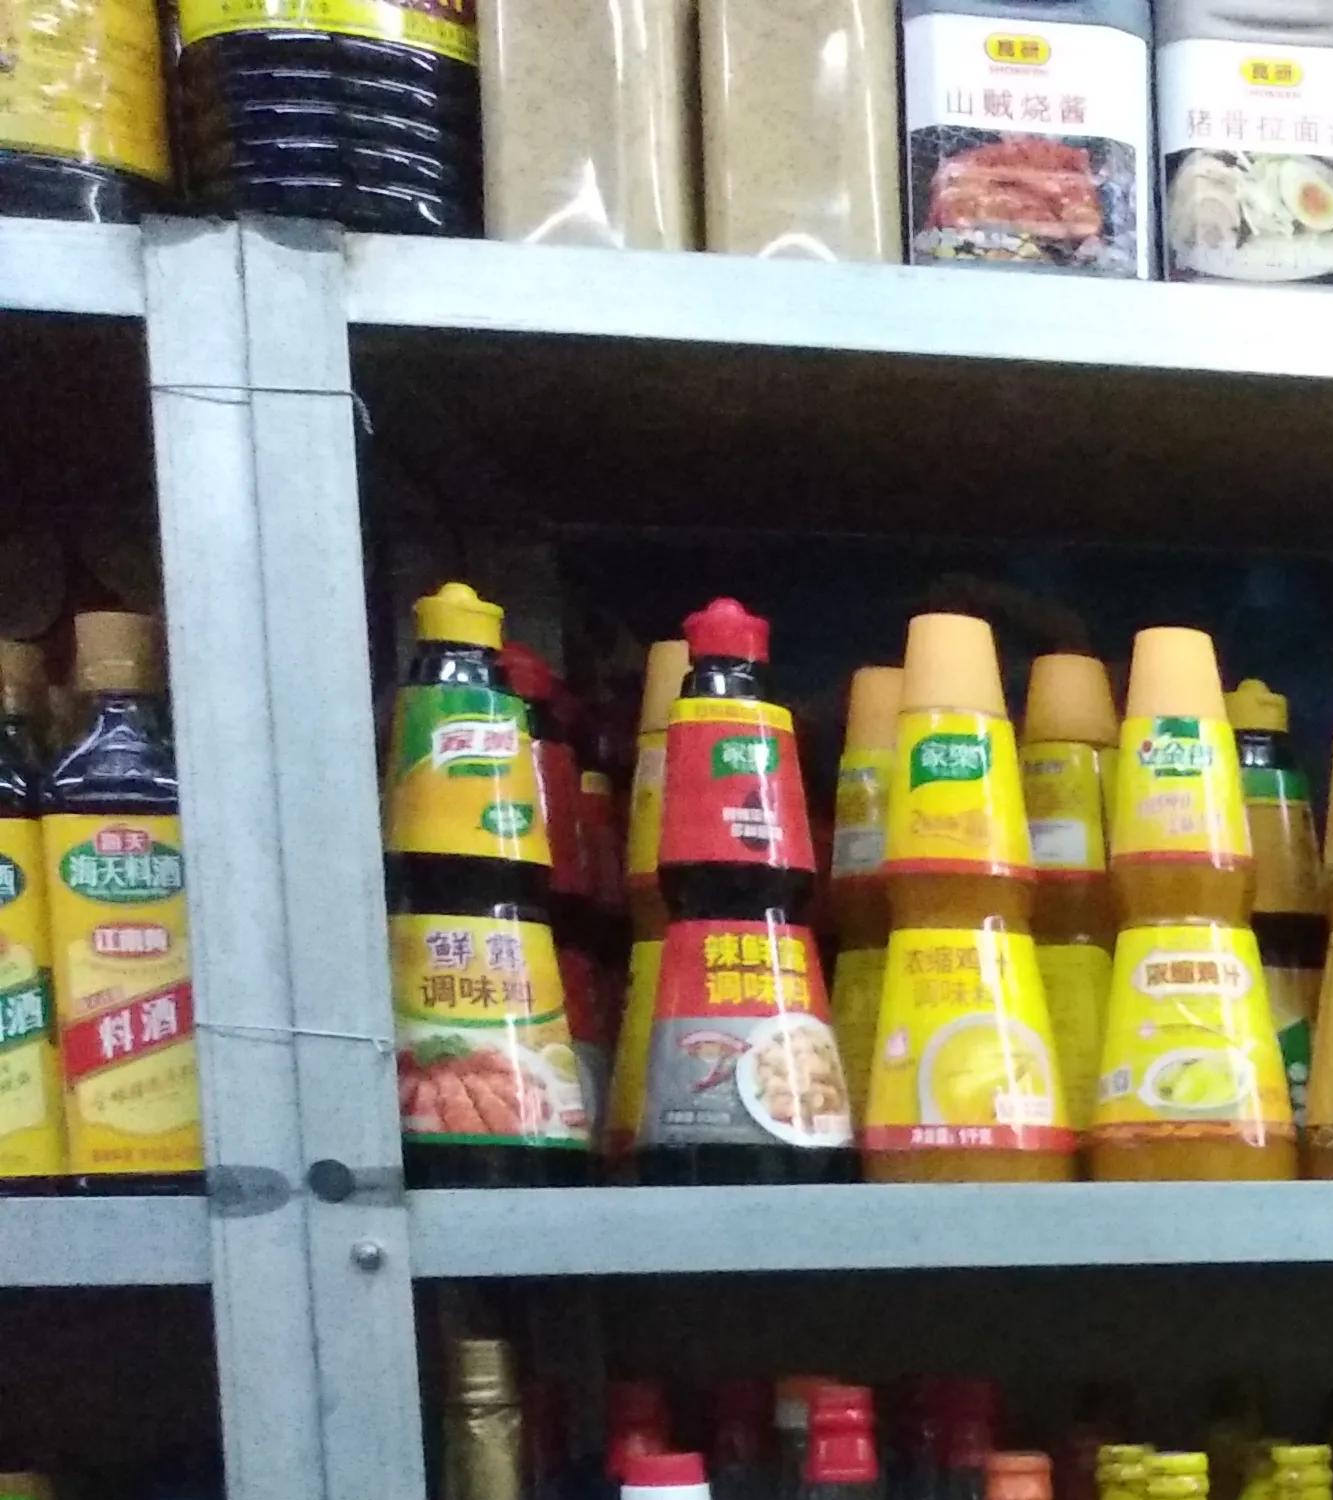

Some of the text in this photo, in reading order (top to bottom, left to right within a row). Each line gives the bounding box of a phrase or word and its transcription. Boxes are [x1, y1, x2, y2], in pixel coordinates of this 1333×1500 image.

[946, 87, 1087, 124] 山贼烧酱
[70, 853, 182, 889] 海天料酒
[426, 931, 522, 970] 鲜露
[419, 975, 533, 1013] 调味料
[705, 971, 811, 1010] 调味料
[98, 992, 178, 1058] 料酒
